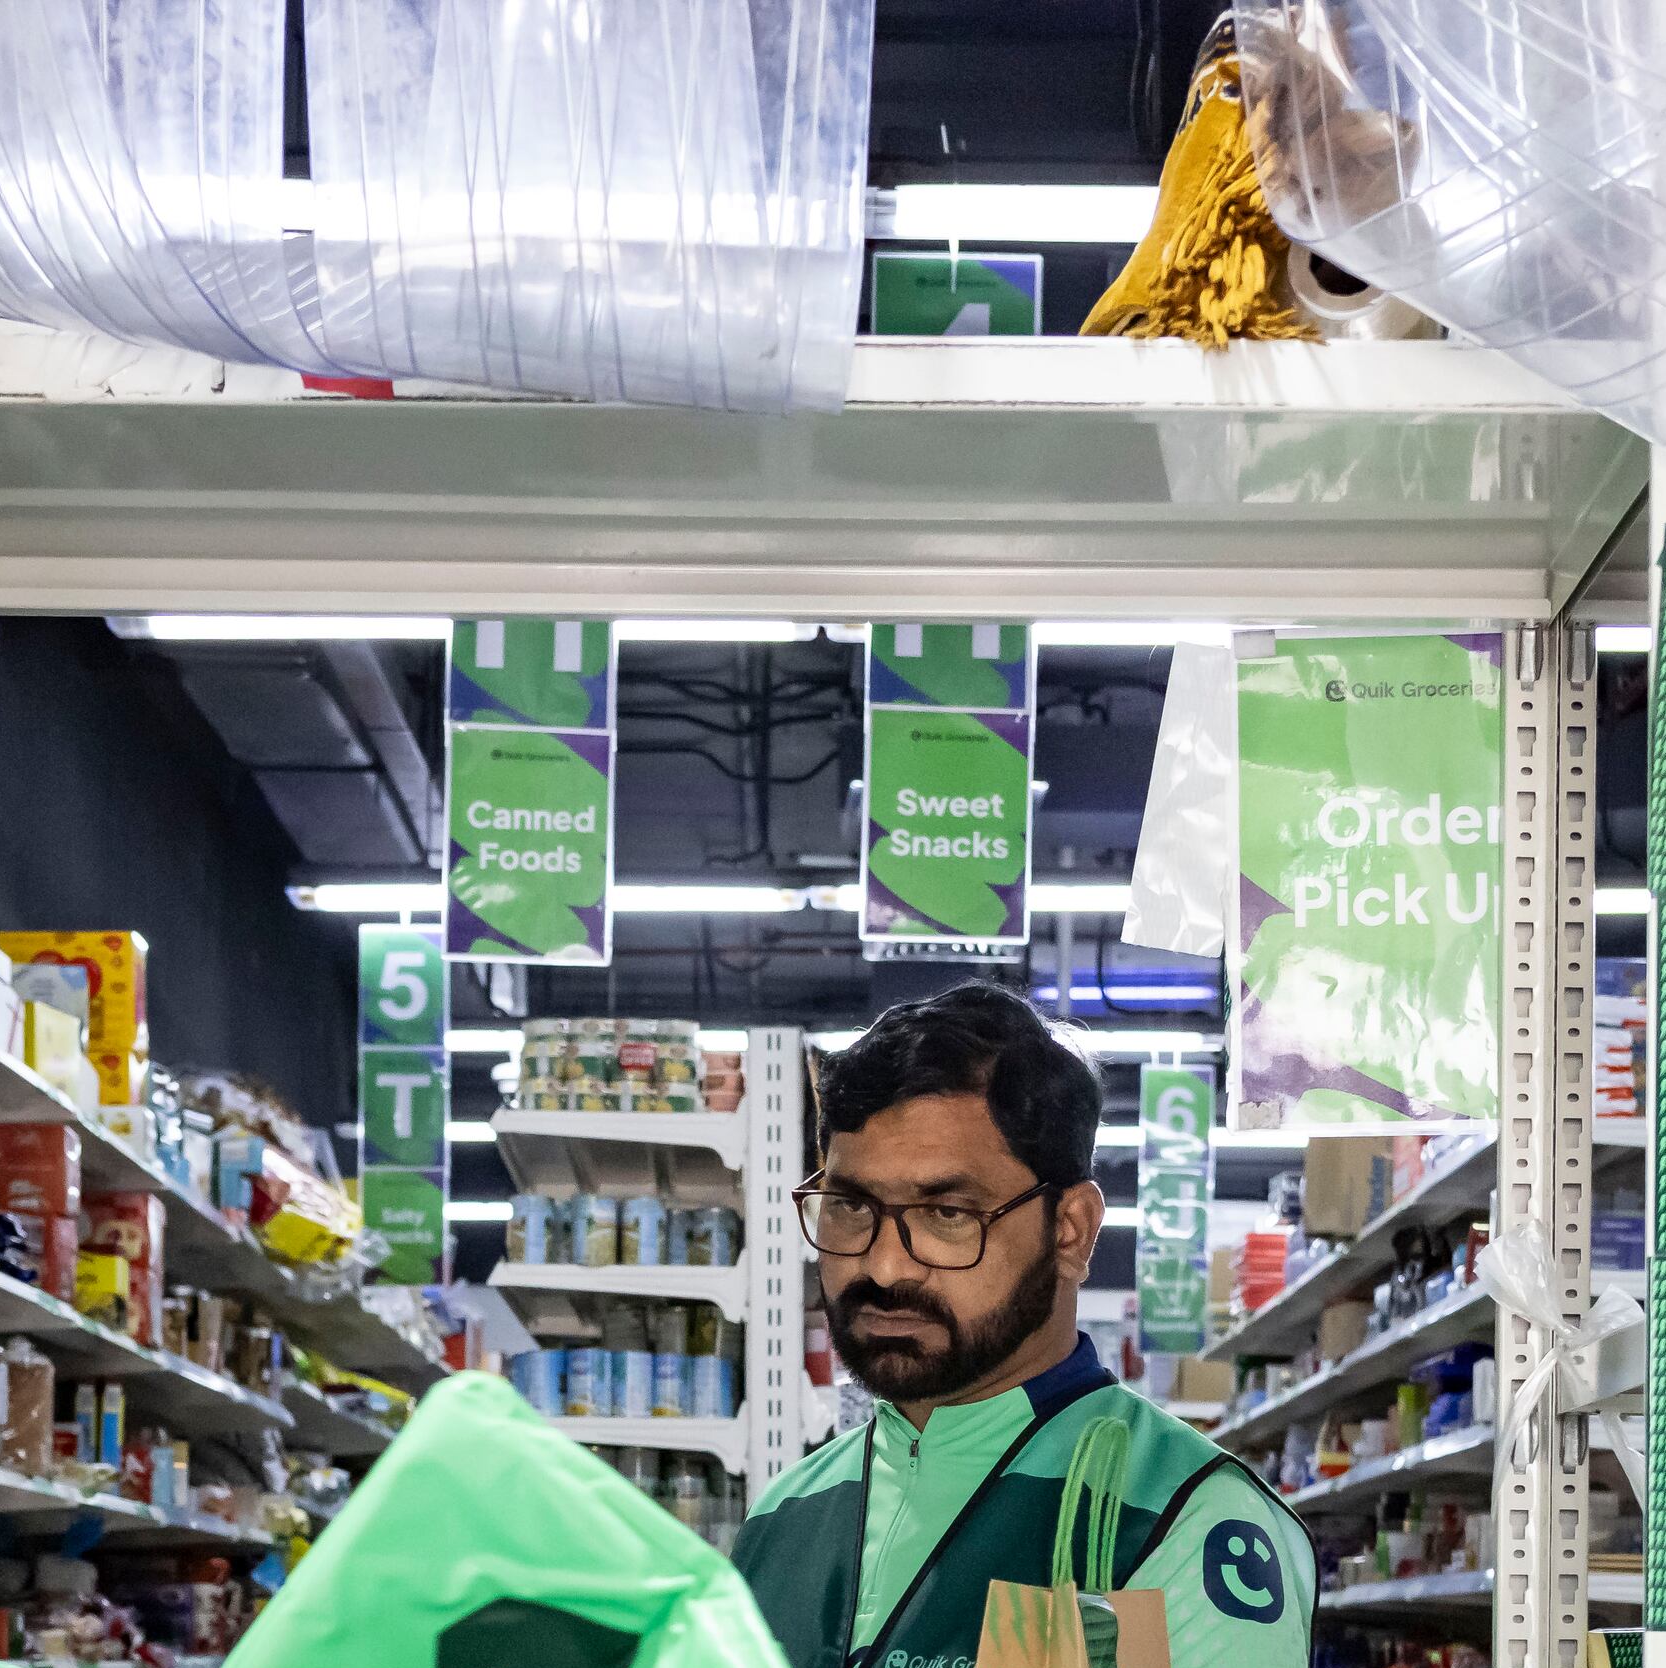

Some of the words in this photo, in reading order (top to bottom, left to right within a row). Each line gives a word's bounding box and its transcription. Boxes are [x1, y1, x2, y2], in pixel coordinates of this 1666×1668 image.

[1351, 681, 1394, 700] Quik
[1402, 680, 1496, 698] Groceries
[467, 800, 596, 833] Canned
[897, 788, 1005, 818] Sweet
[1317, 793, 1501, 848] Order
[478, 842, 582, 874] Foods
[890, 828, 1009, 859] Snacks
[1294, 872, 1430, 928] Pick
[379, 952, 428, 1021] 5
[376, 1072, 431, 1139] T
[1157, 1086, 1198, 1137] 6
